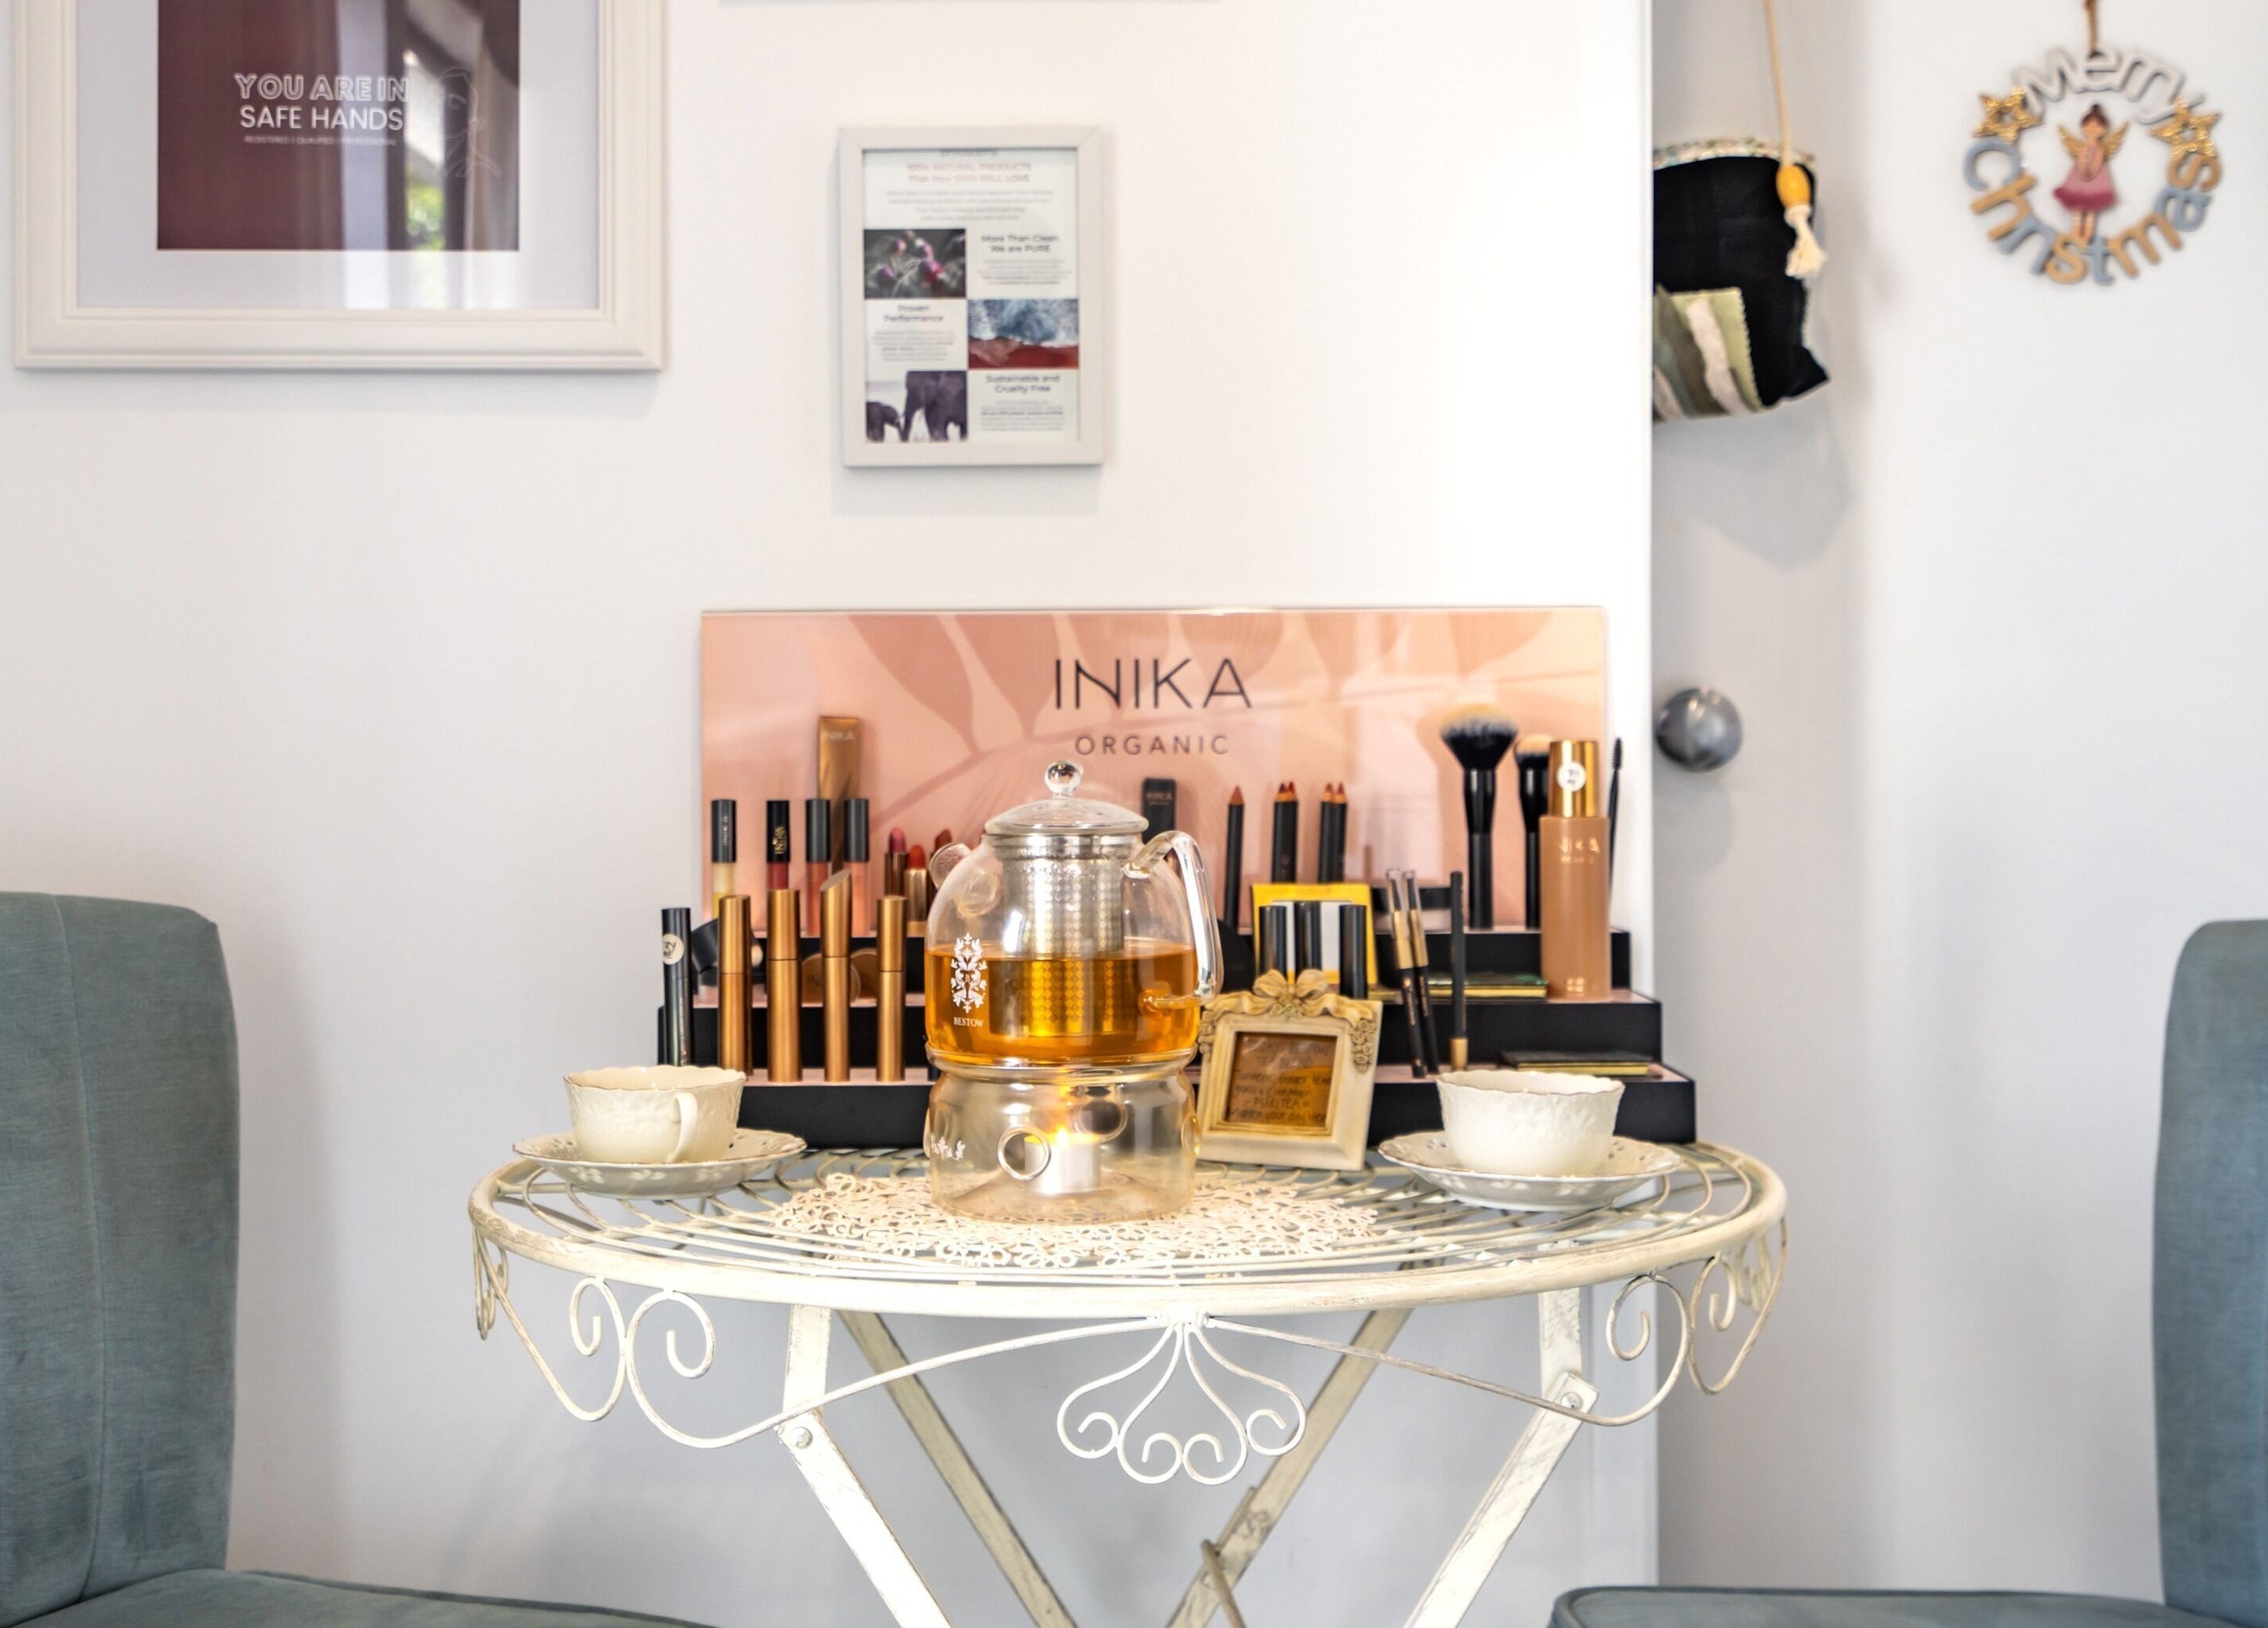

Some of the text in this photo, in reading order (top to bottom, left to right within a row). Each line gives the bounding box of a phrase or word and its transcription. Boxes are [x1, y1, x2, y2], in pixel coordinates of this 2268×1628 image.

[235, 73, 409, 102] YOU ARE IN
[2011, 47, 2206, 126] Merry
[240, 105, 404, 130] SAFE HANDS
[1963, 137, 2222, 285] Christmas
[1055, 659, 1252, 709] INIKA
[1075, 735, 1229, 755] ORGANIC
[954, 1017, 985, 1027] BESTOW
